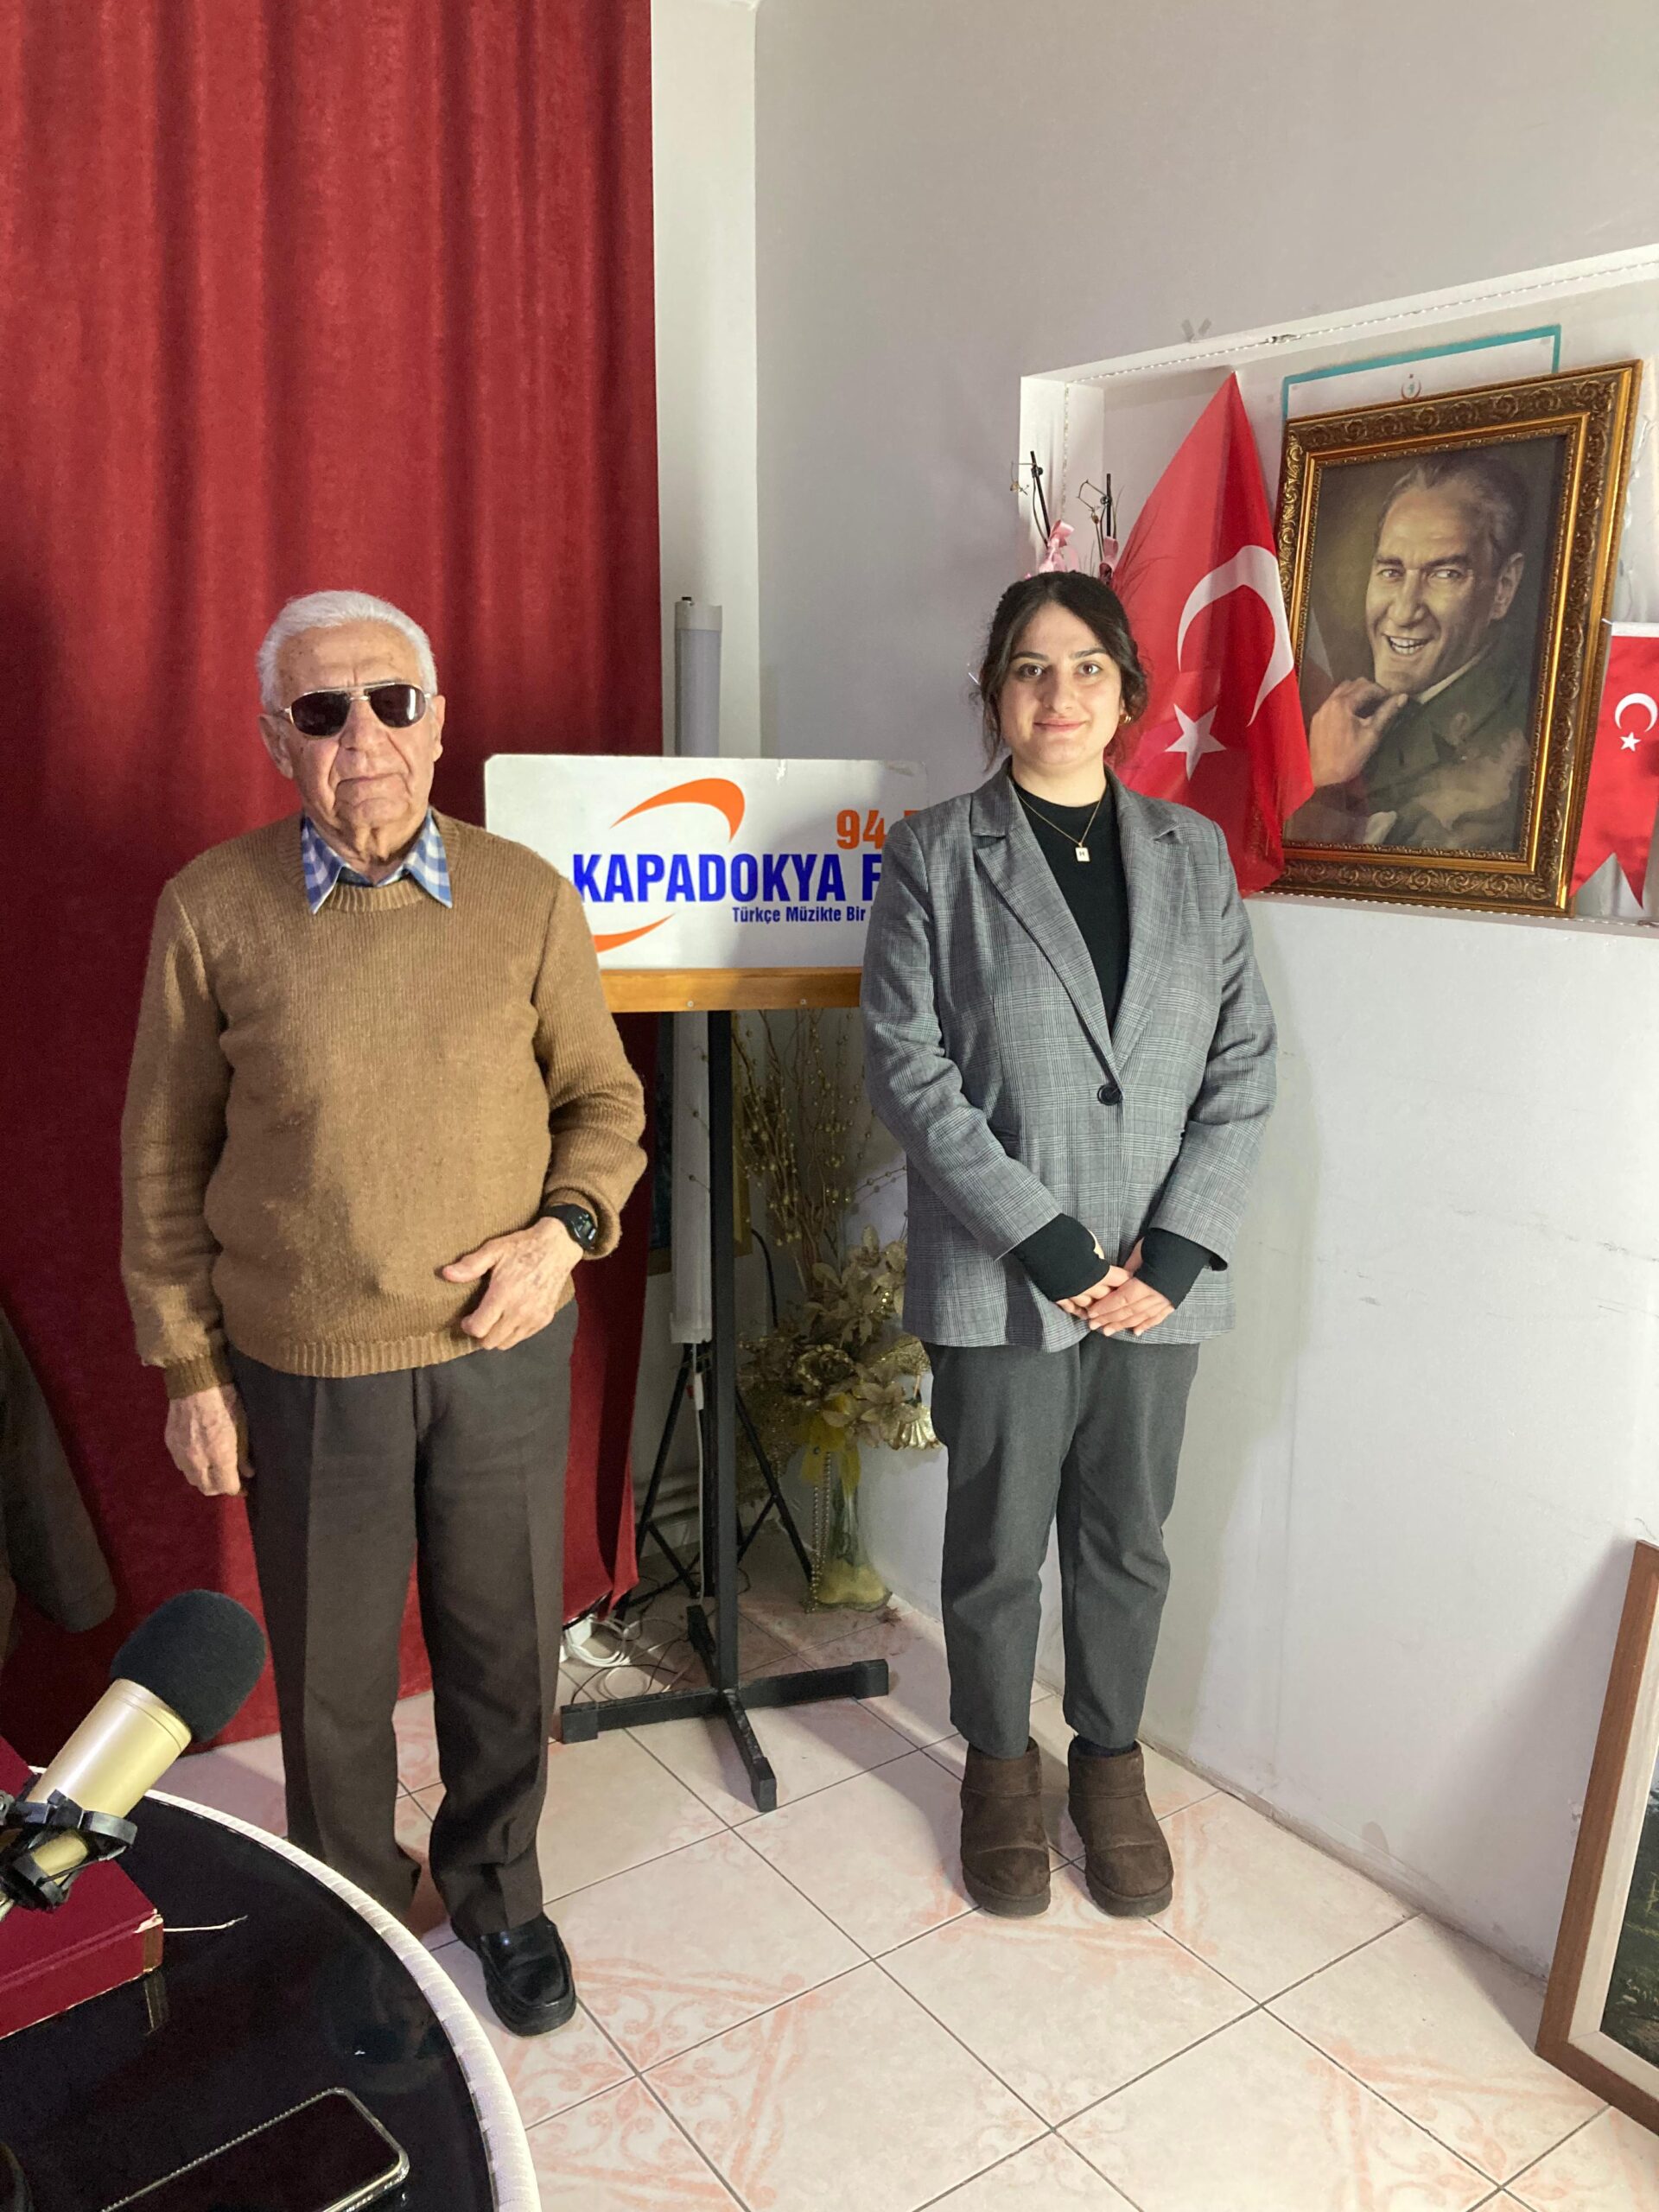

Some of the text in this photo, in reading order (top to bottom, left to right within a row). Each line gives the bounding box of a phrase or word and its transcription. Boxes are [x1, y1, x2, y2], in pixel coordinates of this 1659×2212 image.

[836, 809, 919, 850] 94
[573, 854, 882, 902] KAPADOKYA F
[733, 906, 866, 925] Türkçe Müzikte Bir
